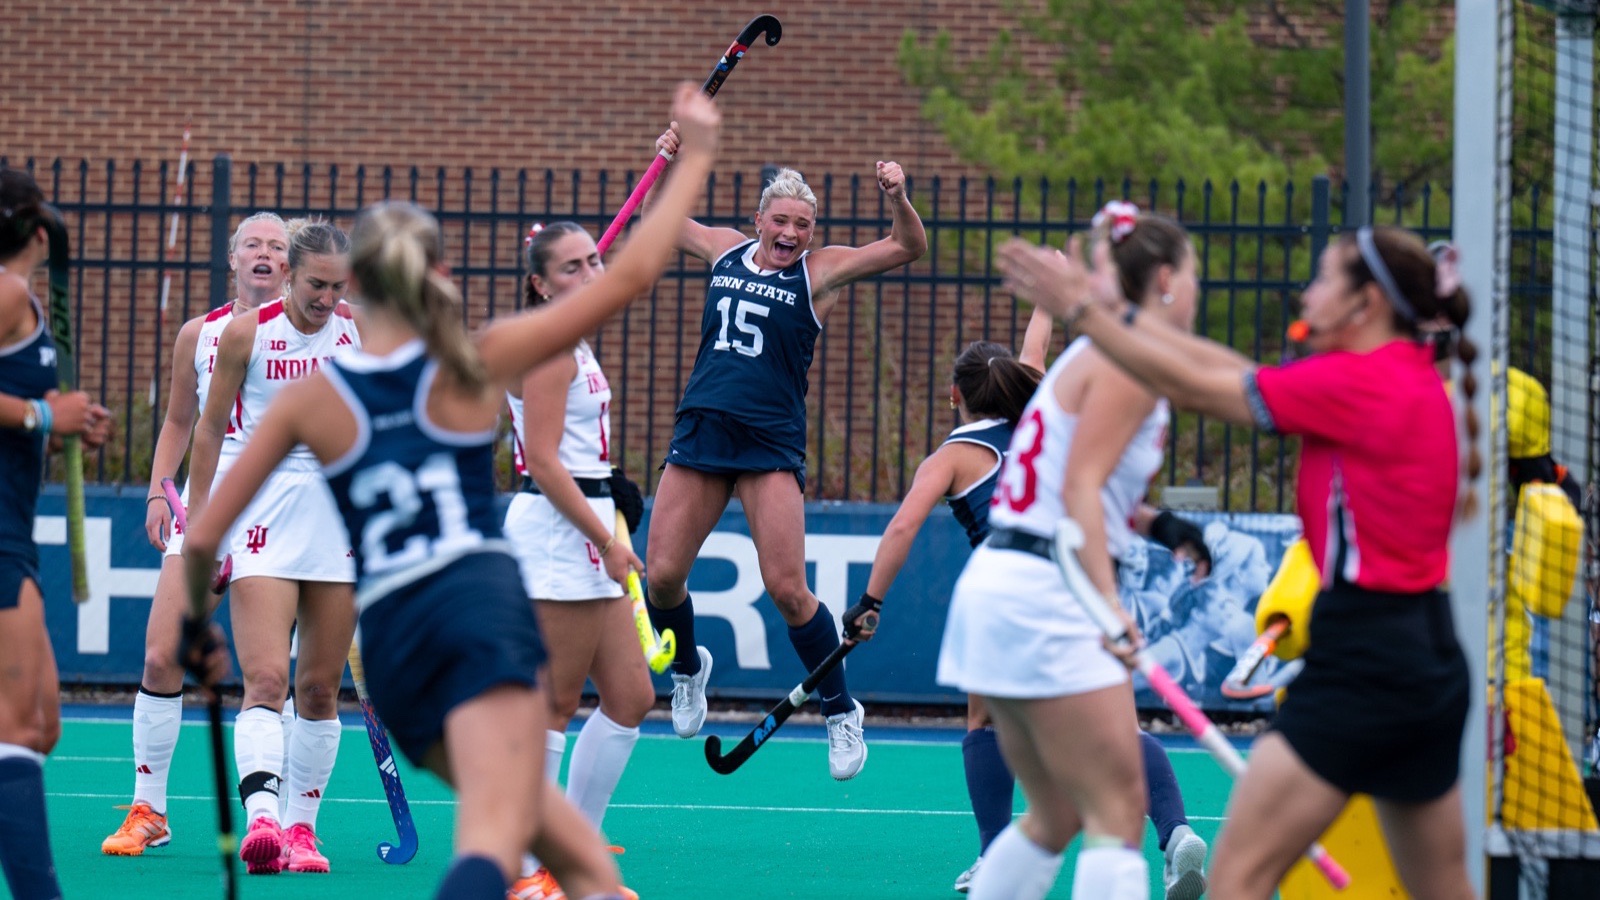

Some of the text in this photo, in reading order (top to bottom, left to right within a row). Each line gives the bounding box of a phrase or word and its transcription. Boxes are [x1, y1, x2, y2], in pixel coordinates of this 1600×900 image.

[710, 275, 797, 306] PENN STATE
[713, 296, 771, 358] 15
[990, 409, 1045, 514] 3
[349, 451, 484, 574] 21
